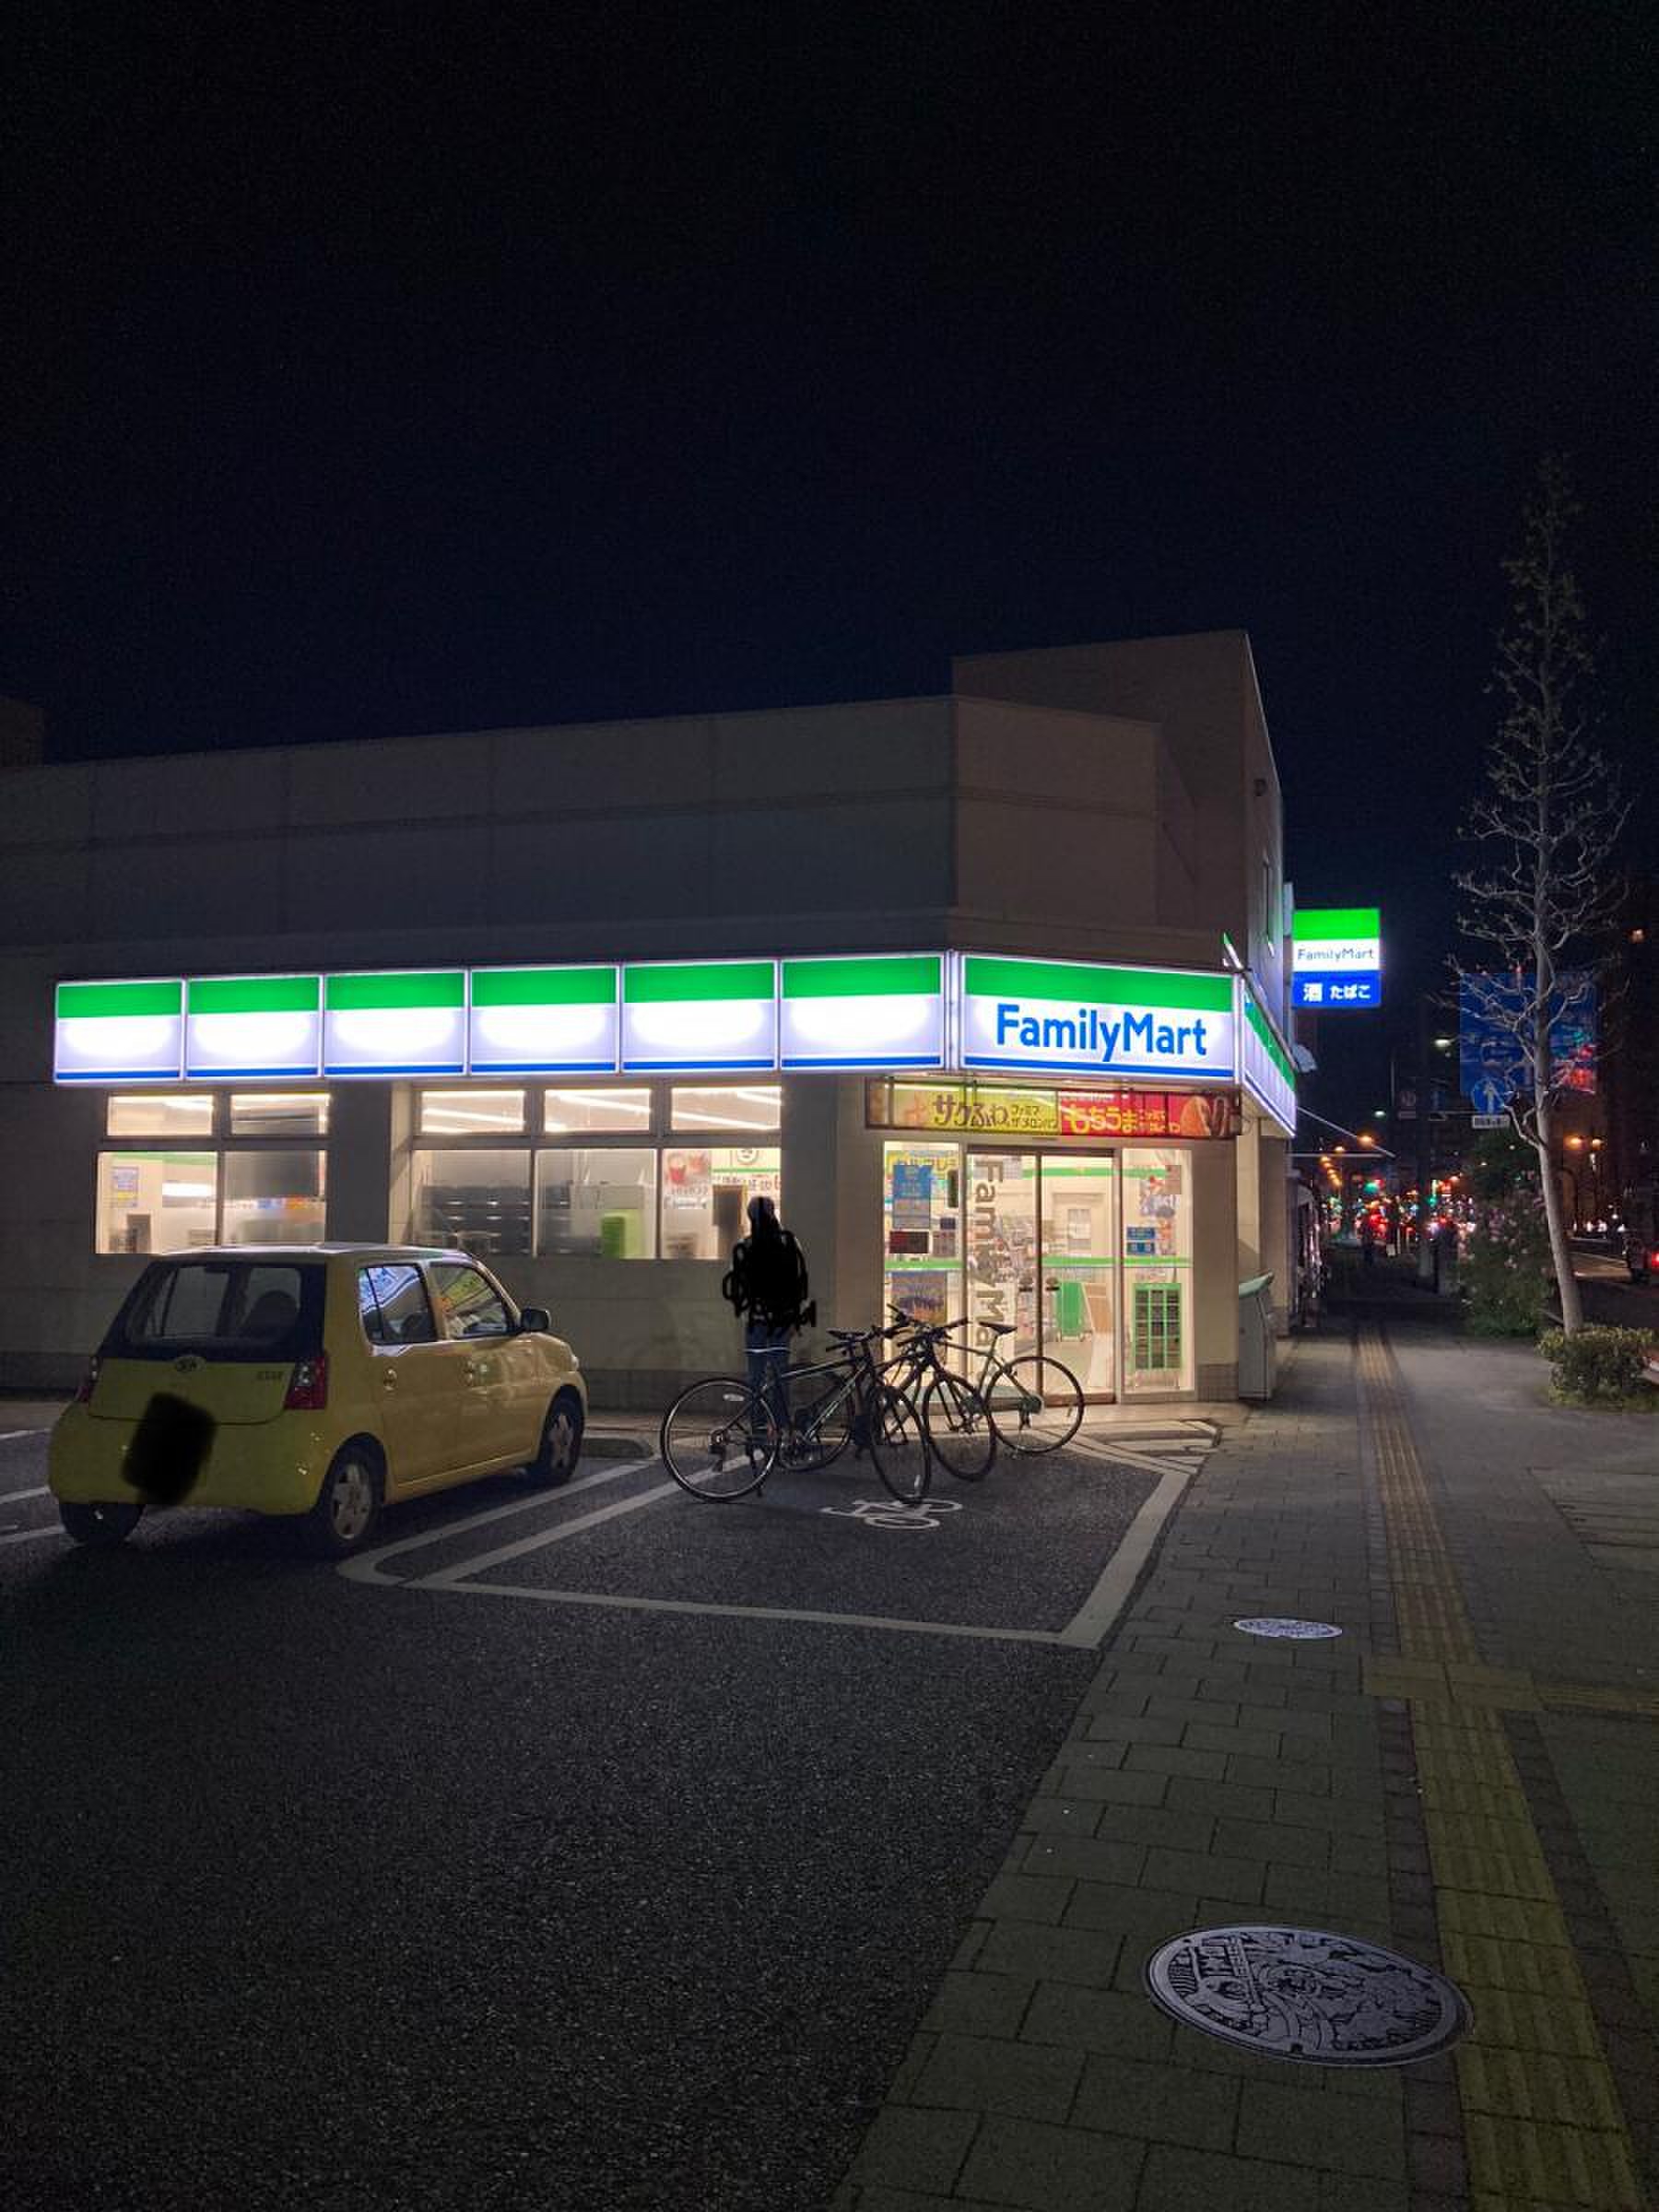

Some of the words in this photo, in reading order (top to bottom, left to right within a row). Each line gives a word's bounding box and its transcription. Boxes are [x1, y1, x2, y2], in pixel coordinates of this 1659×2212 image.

[1297, 947, 1374, 962] FamilyMart
[1303, 982, 1323, 1002] 酒
[1330, 983, 1371, 1001] たばこ
[996, 1003, 1206, 1062] FamilyMart
